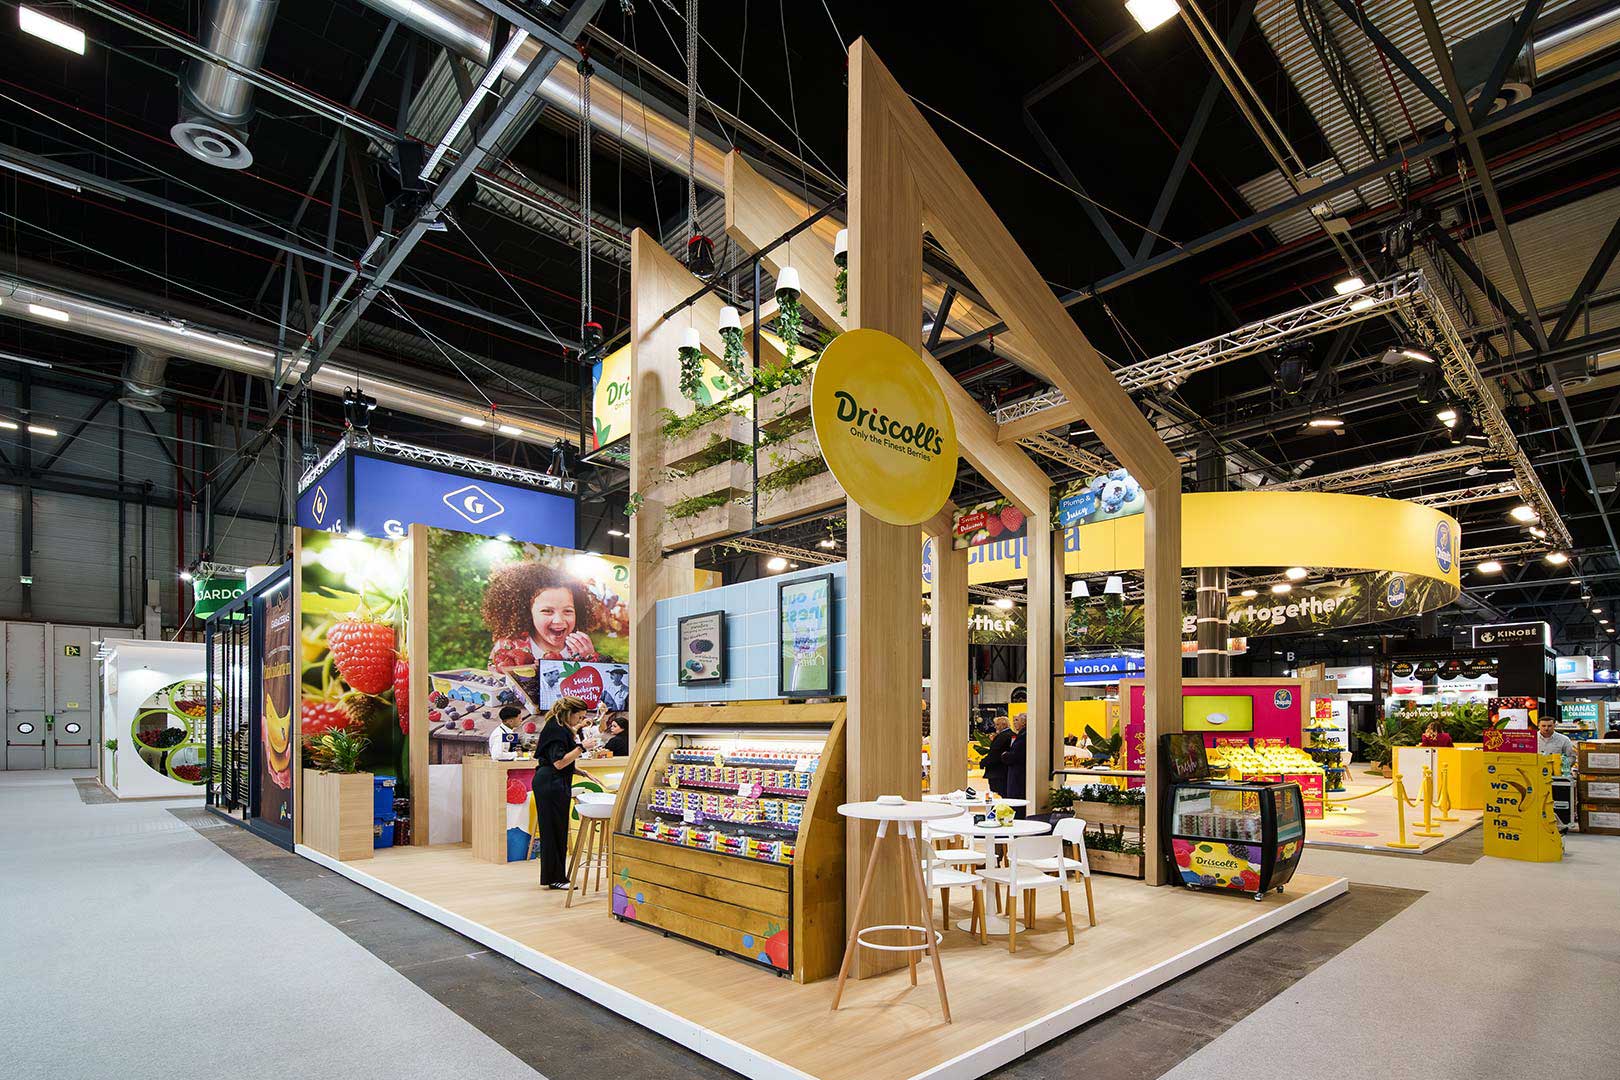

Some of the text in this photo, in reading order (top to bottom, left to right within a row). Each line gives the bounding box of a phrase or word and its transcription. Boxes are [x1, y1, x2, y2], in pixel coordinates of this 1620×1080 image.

[606, 376, 631, 405] Dri
[834, 391, 944, 455] Driscoll's
[850, 427, 931, 461] Only the Finest Berries
[1063, 498, 1085, 507] Plump
[1066, 506, 1088, 521] Juicy
[961, 515, 979, 524] Sweet
[1247, 596, 1346, 625] together
[1497, 628, 1537, 638] KINOBÉ
[1286, 651, 1295, 661] B
[1490, 782, 1508, 790] we
[1496, 797, 1518, 806] are
[1486, 804, 1501, 813] ba
[1493, 819, 1508, 828] na
[1498, 831, 1520, 841] nas
[1195, 856, 1239, 869] Driscoll's
